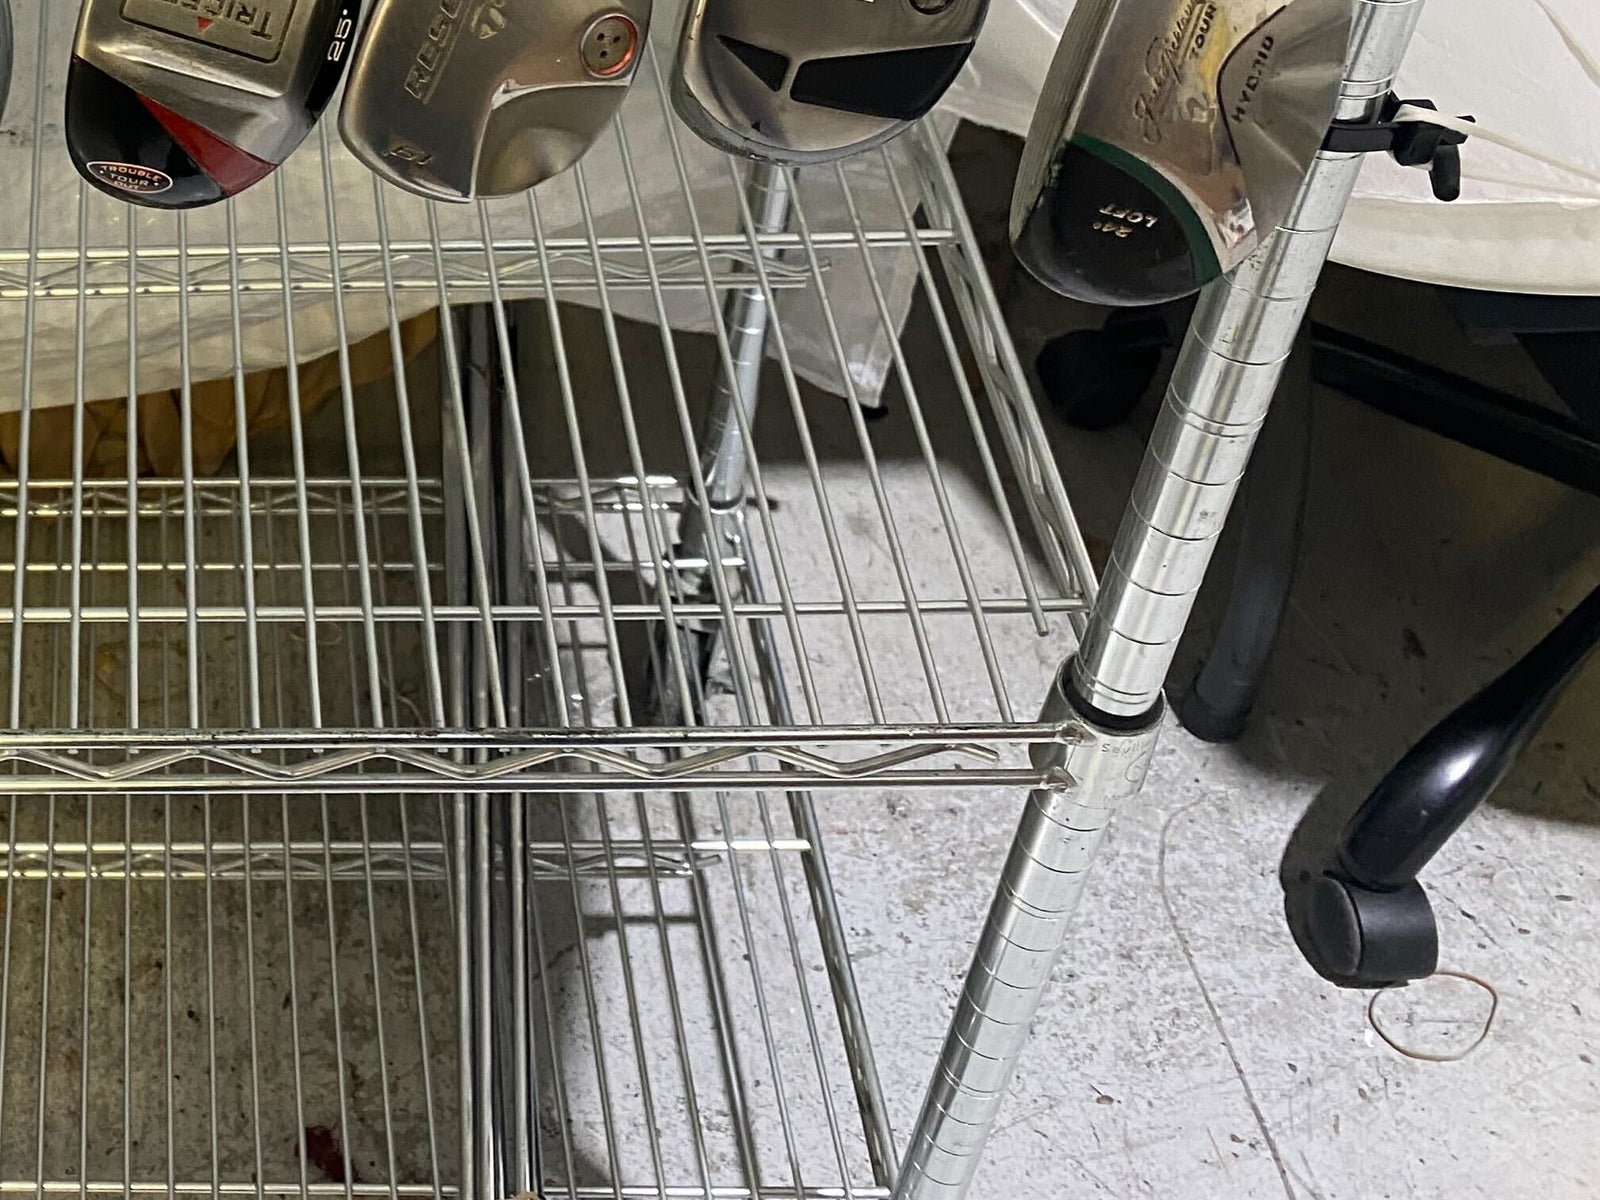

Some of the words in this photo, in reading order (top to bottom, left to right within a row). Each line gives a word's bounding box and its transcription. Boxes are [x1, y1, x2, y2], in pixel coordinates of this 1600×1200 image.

[100, 165, 162, 182] TROUBLE
[110, 173, 150, 187] TOUR
[1099, 203, 1158, 228] LOFT
